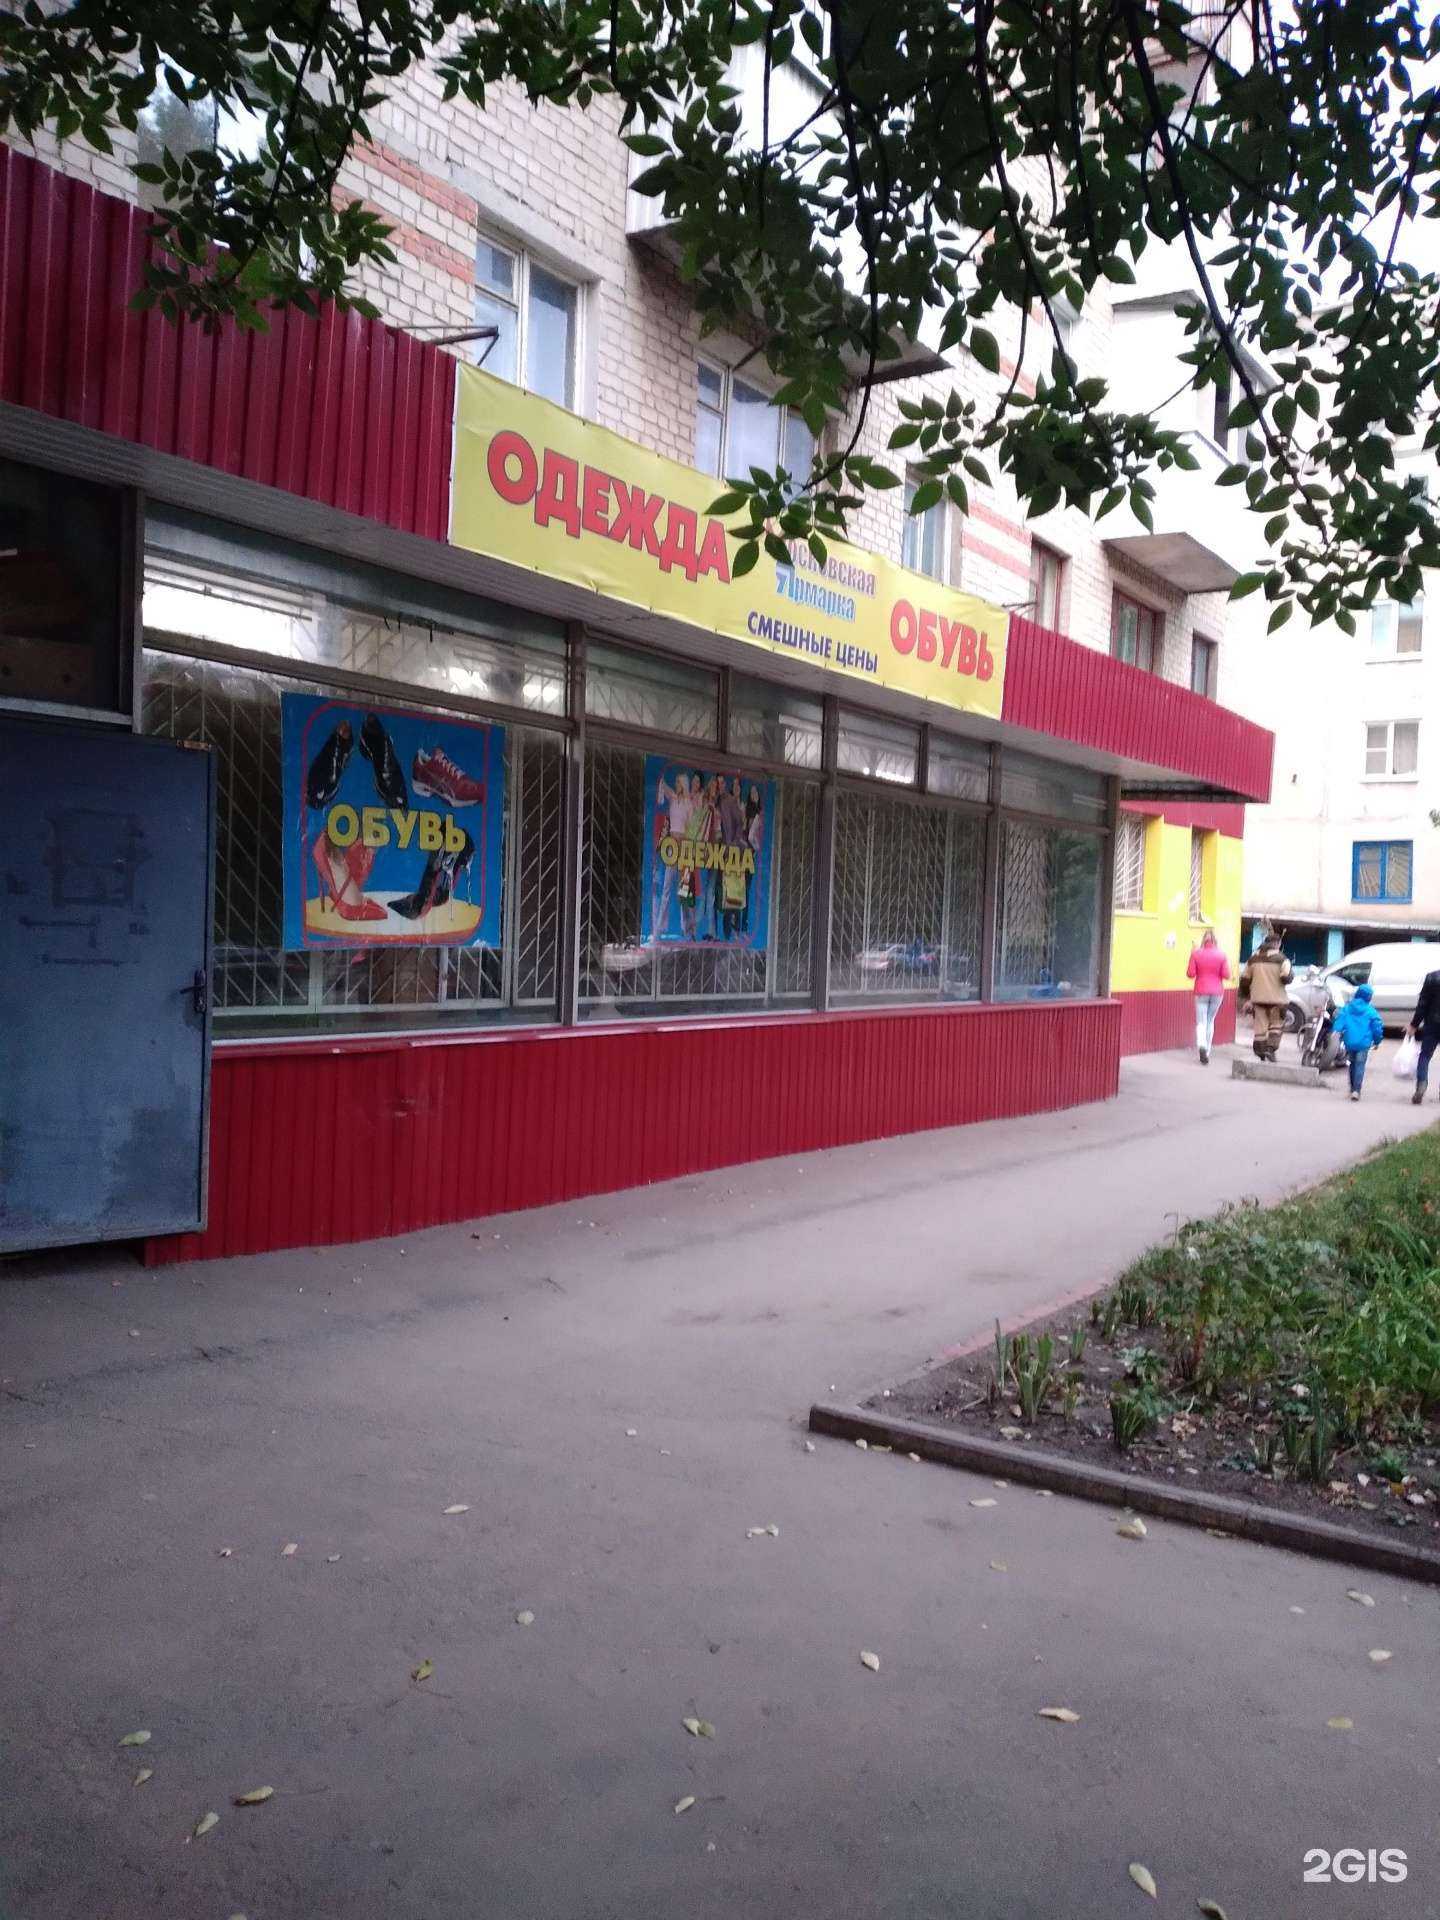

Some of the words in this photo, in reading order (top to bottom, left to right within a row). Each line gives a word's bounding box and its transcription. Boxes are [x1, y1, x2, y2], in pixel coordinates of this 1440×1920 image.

[487, 430, 731, 583] ОДЕЖДА
[764, 517, 877, 597] осквская
[747, 611, 833, 659] СМЕШНЫЕ
[836, 641, 878, 673] ЦЕНЫ
[890, 599, 994, 682] ОБУВЬ
[327, 803, 466, 853] ОБУВЬ
[659, 836, 755, 876] ОДЕЖДА
